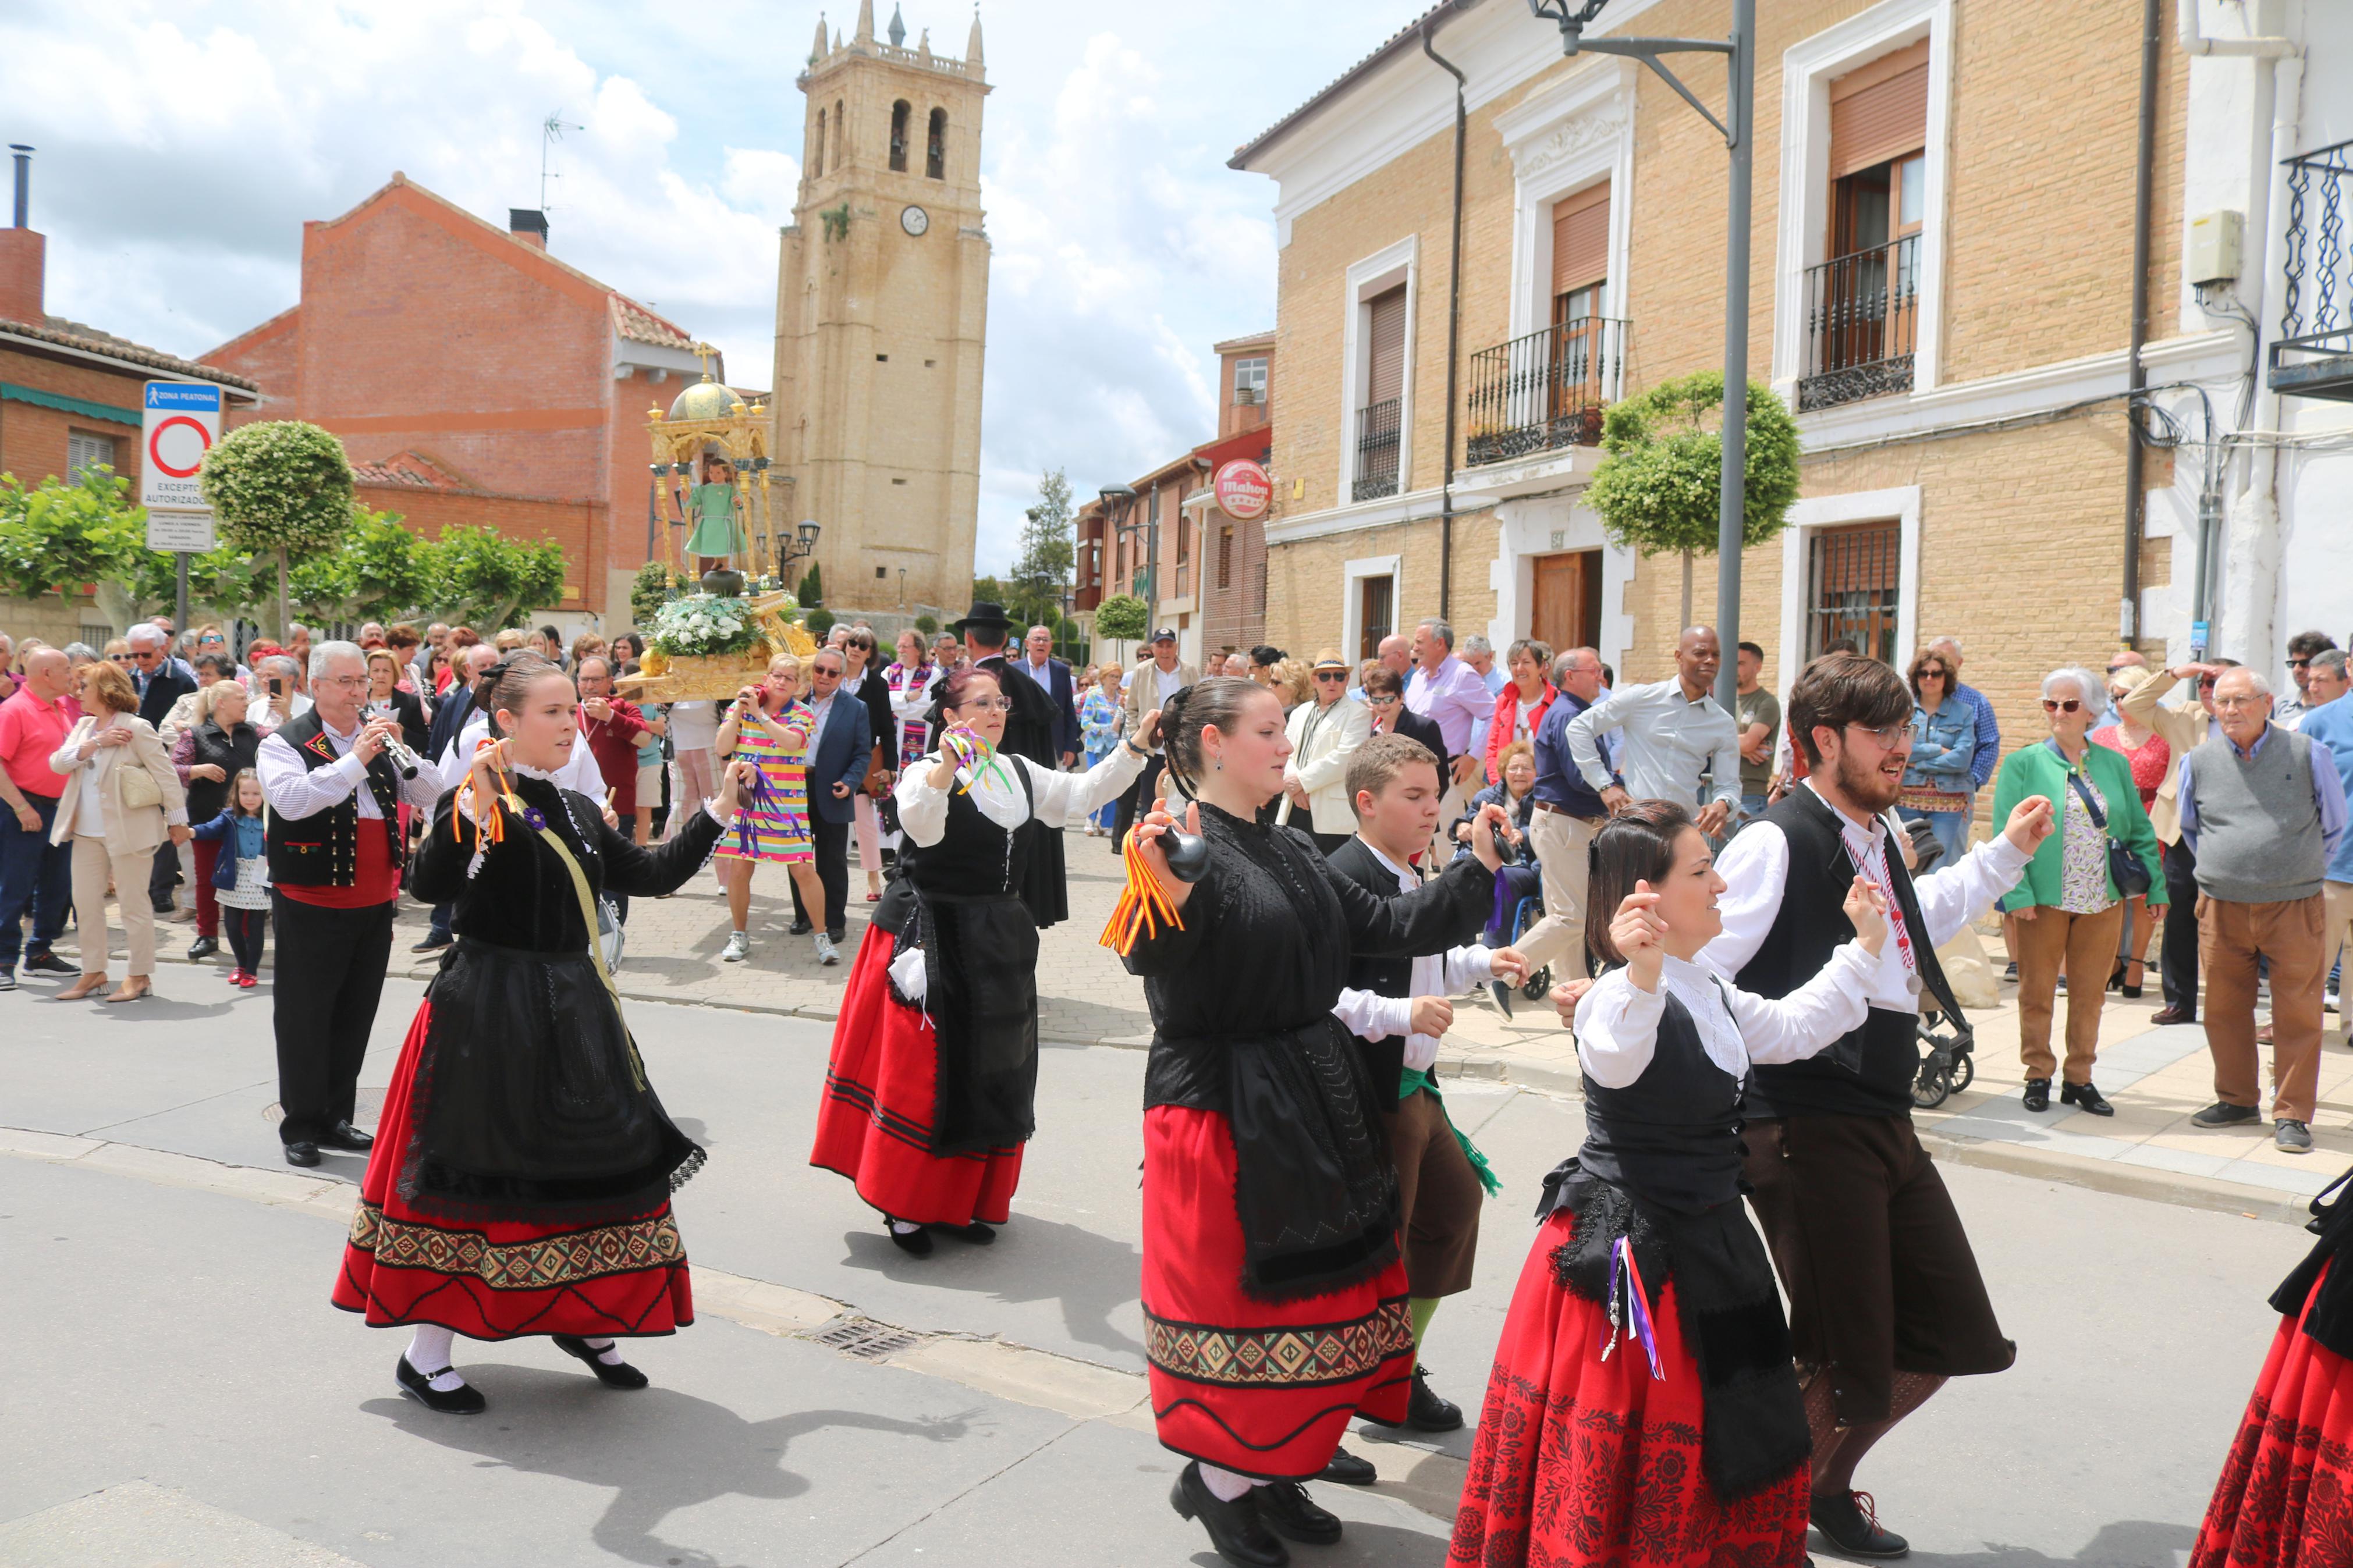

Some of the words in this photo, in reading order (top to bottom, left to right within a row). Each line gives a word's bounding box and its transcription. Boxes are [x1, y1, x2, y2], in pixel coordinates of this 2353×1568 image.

[158, 392, 179, 400] ZONA
[180, 393, 218, 401] PEATONAL
[158, 483, 200, 492] EXCEPTO
[1223, 482, 1268, 495] Mahou
[146, 494, 206, 504] AUTORIZADO
